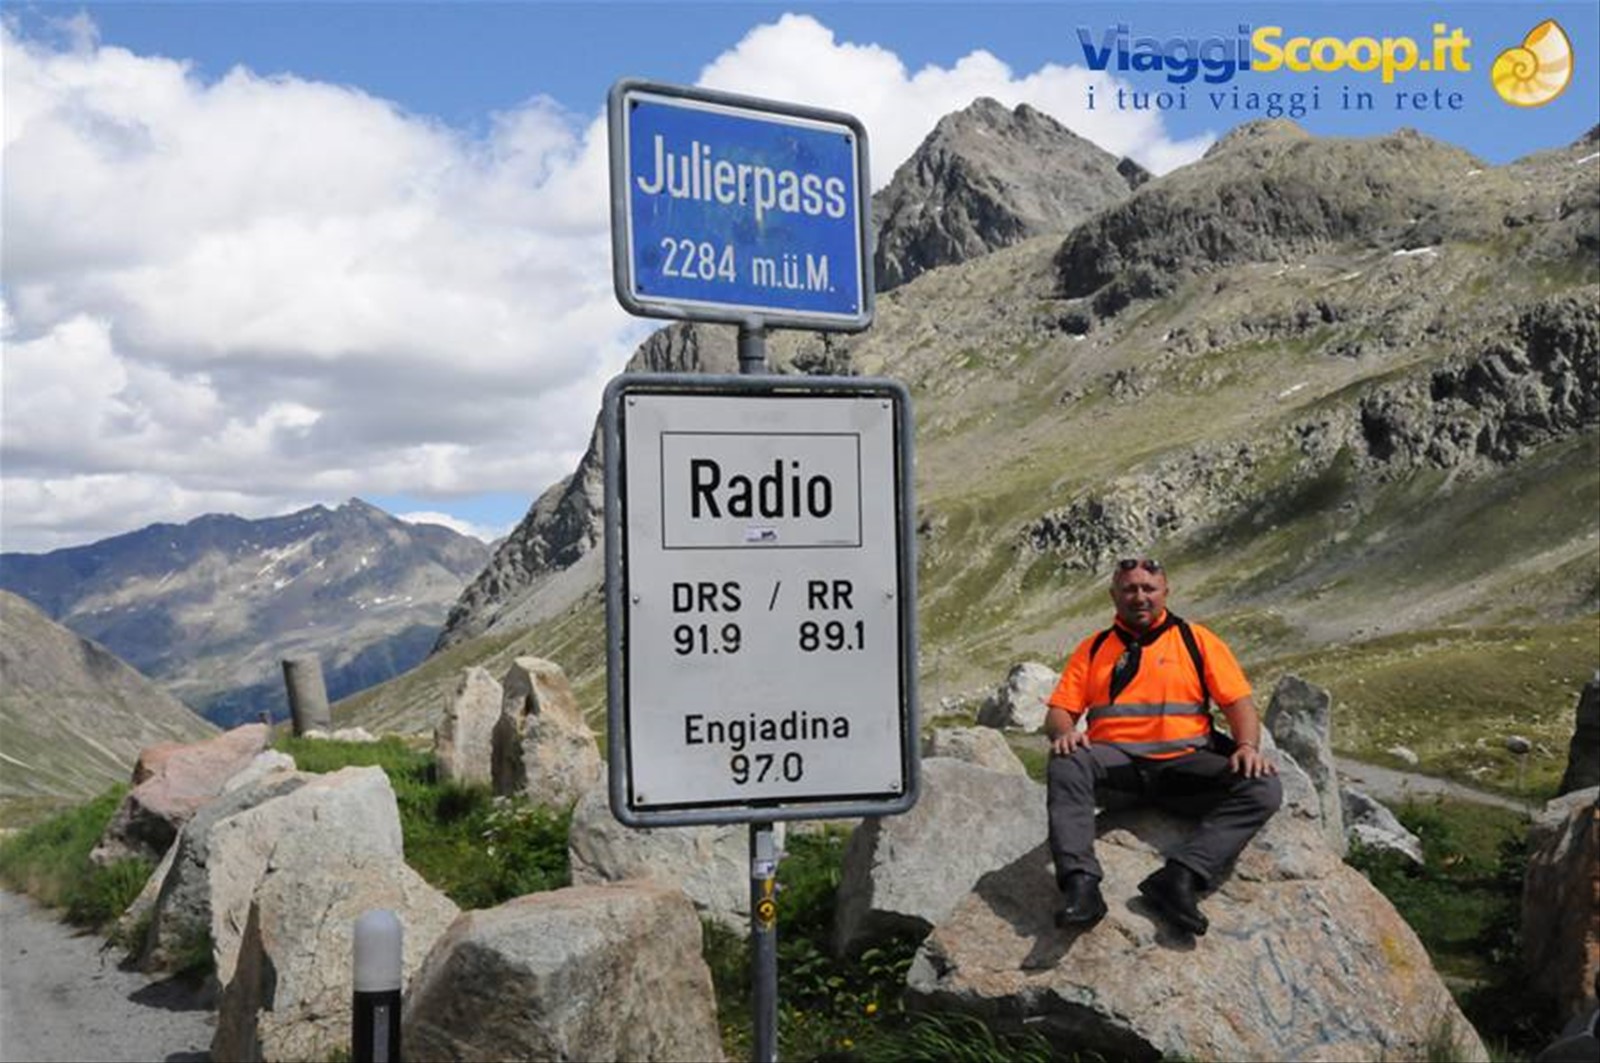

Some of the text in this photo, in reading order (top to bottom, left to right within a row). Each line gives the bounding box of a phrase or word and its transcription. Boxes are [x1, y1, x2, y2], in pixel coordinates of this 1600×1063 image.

[637, 134, 847, 221] Julierpass
[661, 237, 836, 292] 2284 m.ü.M.
[690, 458, 833, 519] Radio
[672, 579, 854, 613] DRS / RR
[673, 620, 865, 655] 91.9 89.1
[685, 711, 850, 752] Engiadina
[730, 751, 804, 785] 97.0
